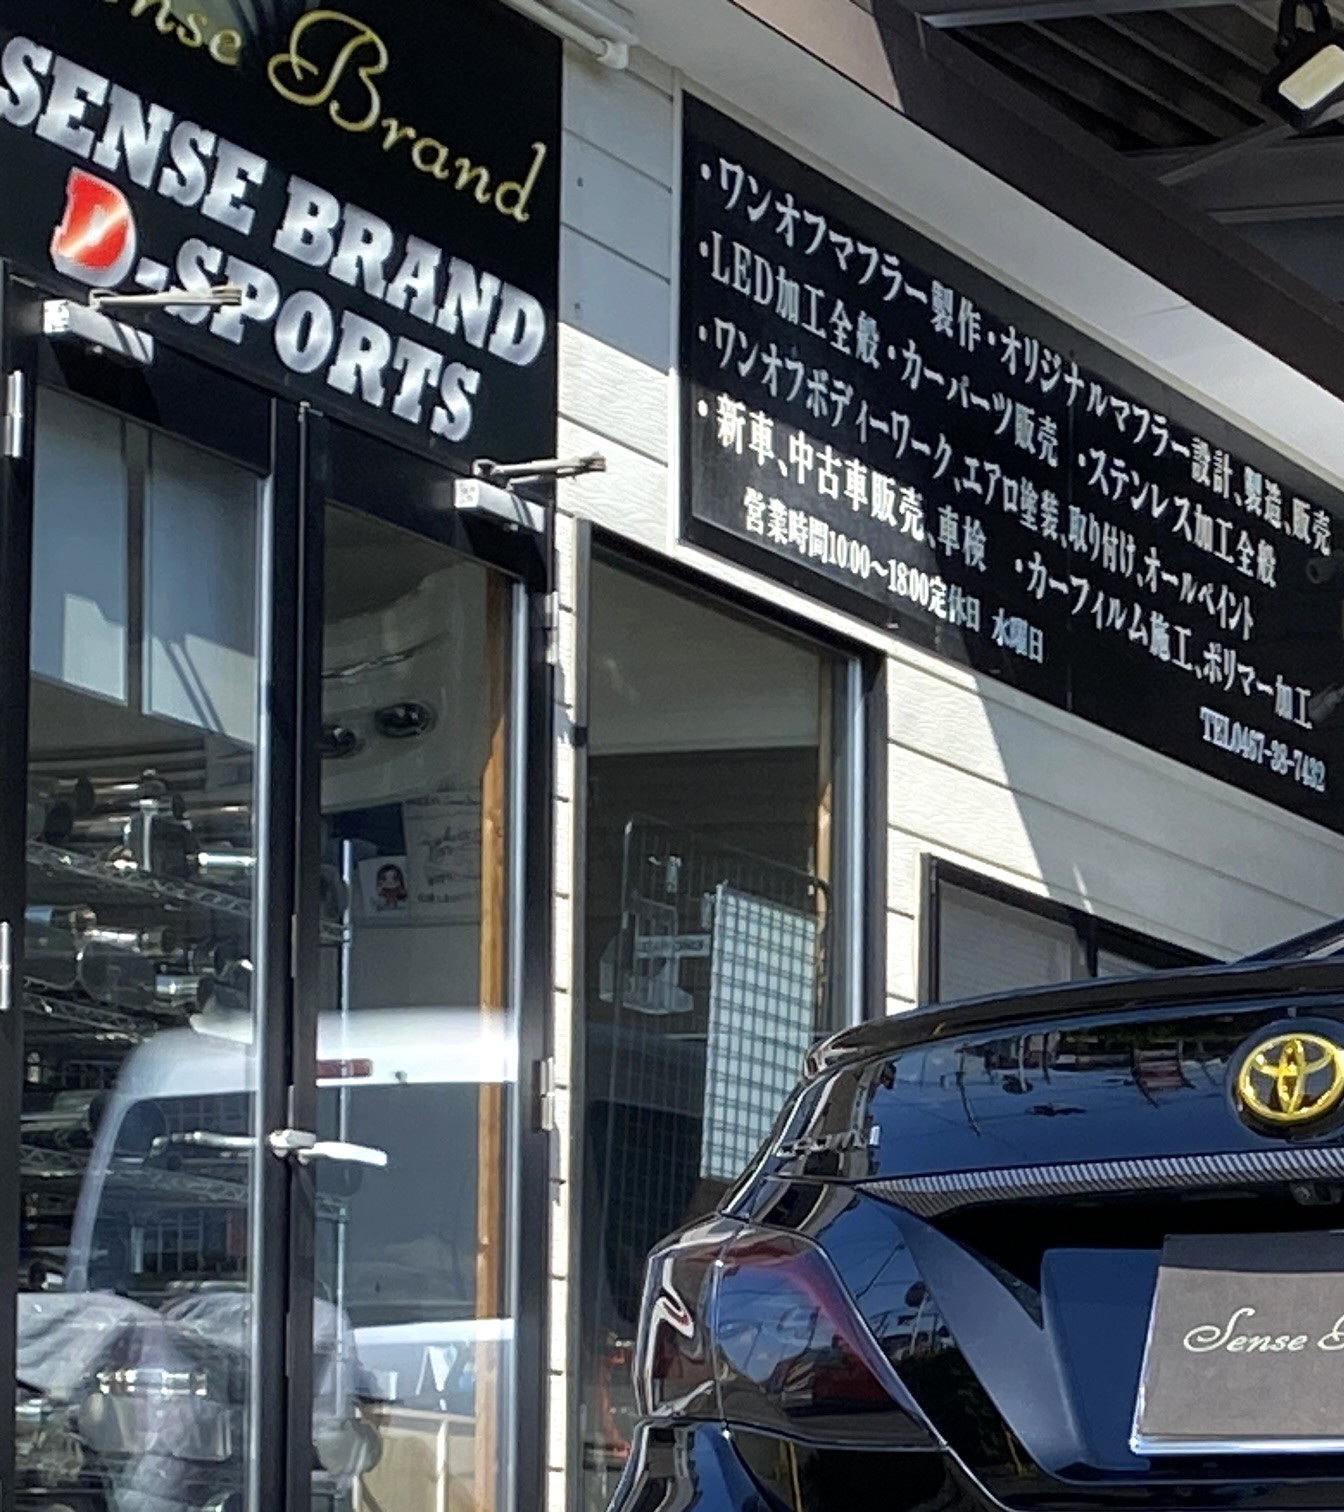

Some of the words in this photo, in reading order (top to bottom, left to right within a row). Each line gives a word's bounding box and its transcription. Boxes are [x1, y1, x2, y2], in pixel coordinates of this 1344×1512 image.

[0, 35, 268, 235] SENSE
[273, 174, 547, 367] BRAND
[268, 9, 547, 222] Brand
[1183, 1307, 1308, 1353] Sense
